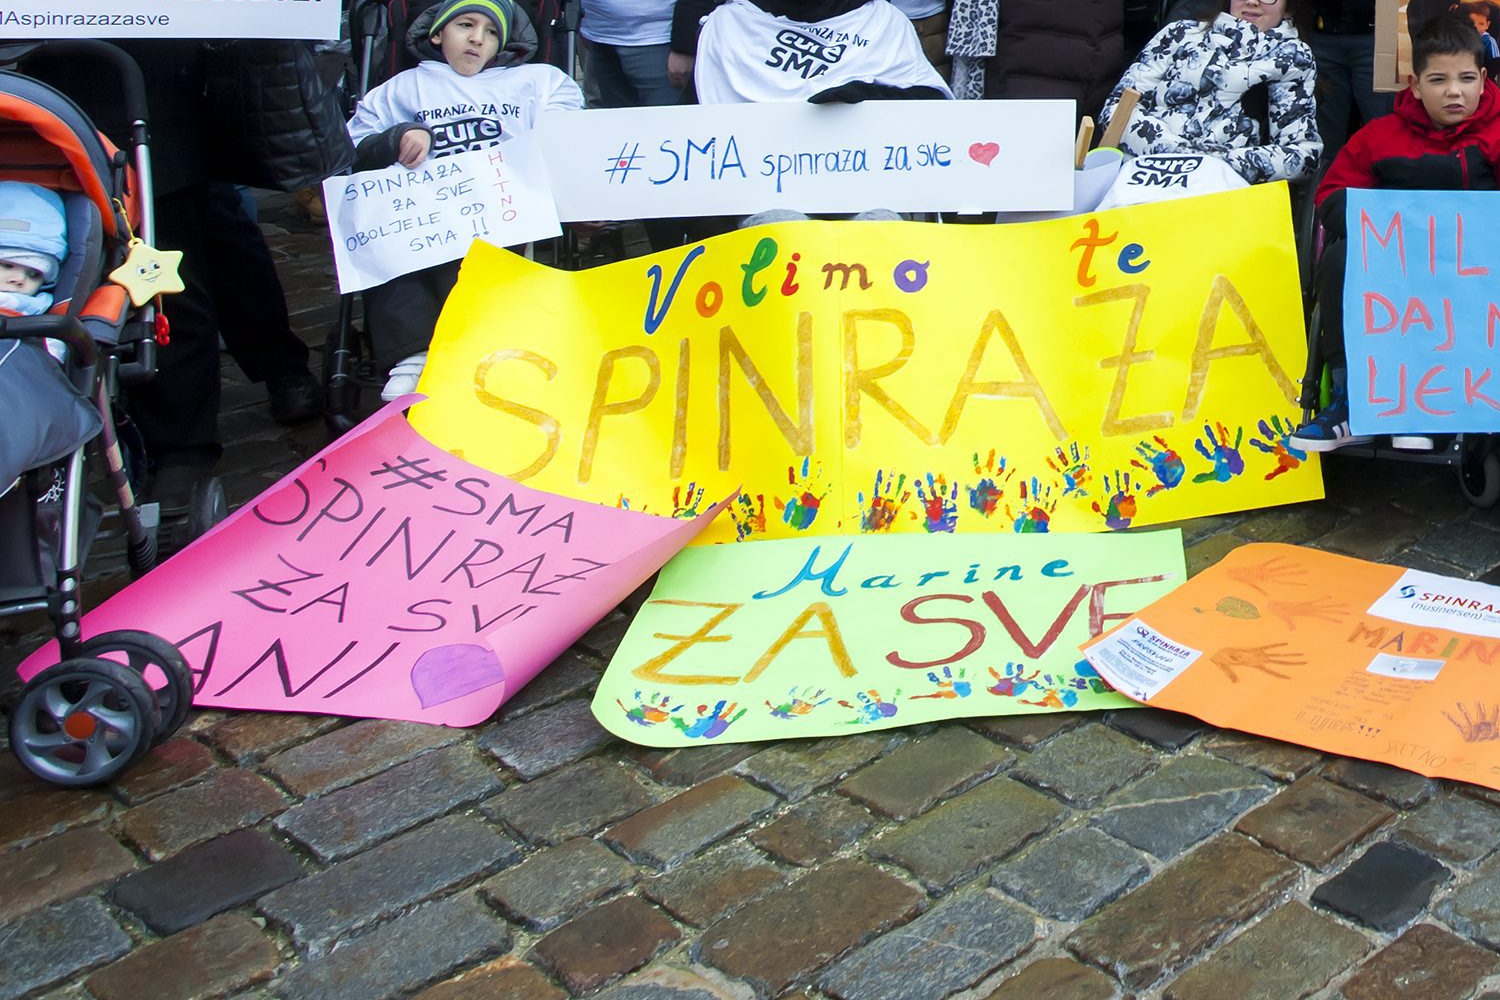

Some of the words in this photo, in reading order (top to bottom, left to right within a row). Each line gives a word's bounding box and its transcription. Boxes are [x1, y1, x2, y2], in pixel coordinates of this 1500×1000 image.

[0, 10, 170, 29] Aspinrazazasve
[835, 33, 848, 43] ZA
[778, 33, 842, 61] cure
[481, 103, 497, 115] ZA
[501, 103, 520, 119] SVE
[433, 120, 500, 146] cure
[344, 163, 462, 201] SPINRAZA
[604, 135, 748, 187] #SMA
[760, 146, 868, 193] spinraza
[884, 142, 912, 171] za
[916, 140, 951, 168] sve
[1127, 171, 1188, 188] SMA
[392, 197, 416, 211] ZA
[435, 177, 475, 202] SVE
[346, 212, 441, 252] OBOLJELE
[460, 202, 485, 216] OD
[409, 229, 457, 252] SMA
[644, 237, 929, 336] Volimo
[1069, 218, 1153, 289] te
[1363, 290, 1457, 351] DAJ
[472, 274, 1303, 485] SPINRAZA
[371, 455, 575, 544] #SMA
[233, 555, 348, 624] ZA
[753, 542, 1075, 600] Marine
[1410, 602, 1483, 621] (nusinersen)
[632, 599, 859, 687] ZA
